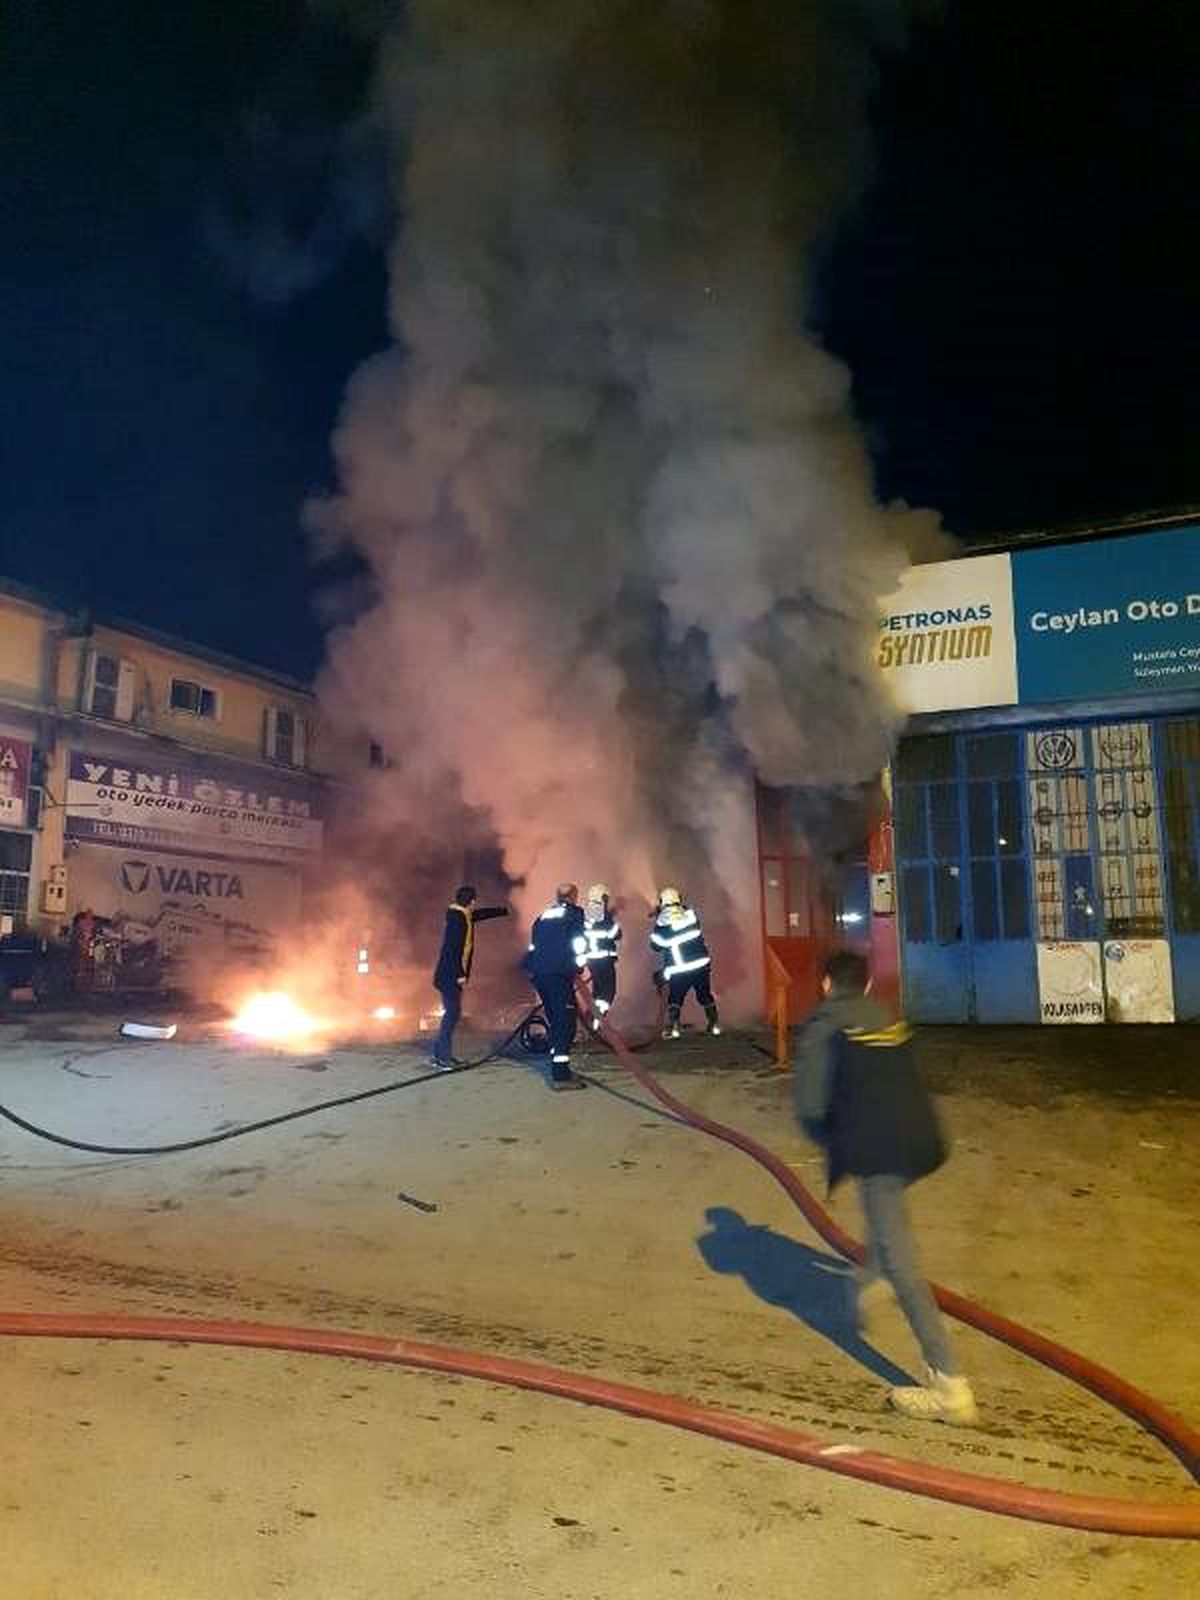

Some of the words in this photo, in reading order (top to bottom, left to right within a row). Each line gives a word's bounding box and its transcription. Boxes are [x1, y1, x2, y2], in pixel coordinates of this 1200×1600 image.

[1031, 608, 1119, 634] Ceylan
[1127, 601, 1179, 620] Oto
[97, 788, 128, 801] oto
[133, 793, 185, 812] yedek
[156, 866, 243, 899] VARTA
